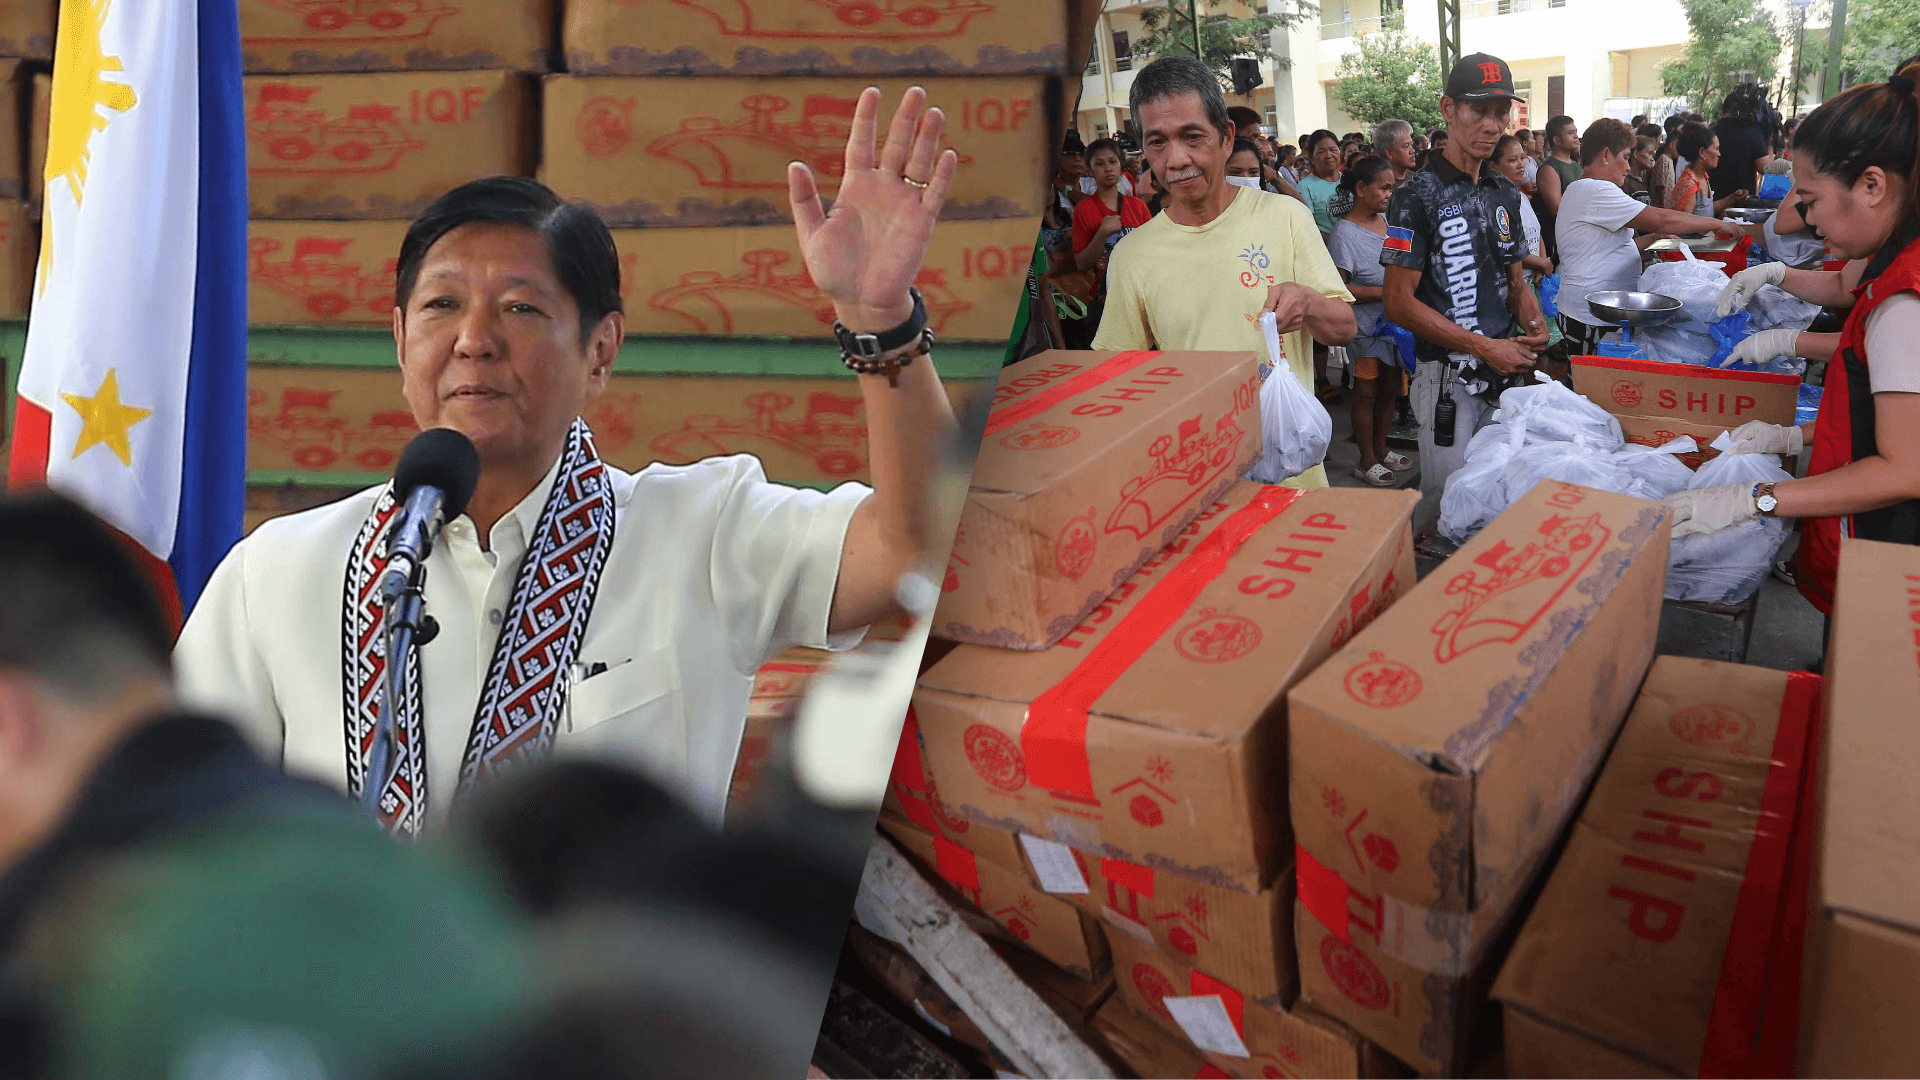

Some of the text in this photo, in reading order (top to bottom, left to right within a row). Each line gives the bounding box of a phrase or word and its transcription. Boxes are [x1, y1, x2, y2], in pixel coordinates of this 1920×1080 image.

[409, 86, 488, 125] IQF
[961, 96, 1031, 132] IQF
[1438, 204, 1463, 219] PGBI
[962, 244, 1034, 279] IQF
[1439, 216, 1484, 336] GUARDIA
[1071, 366, 1184, 418] SHIP
[1233, 375, 1258, 417] IQF
[1658, 388, 1757, 416] SHIP
[1238, 512, 1347, 600] SHIP
[1607, 766, 1726, 944] SHIP
